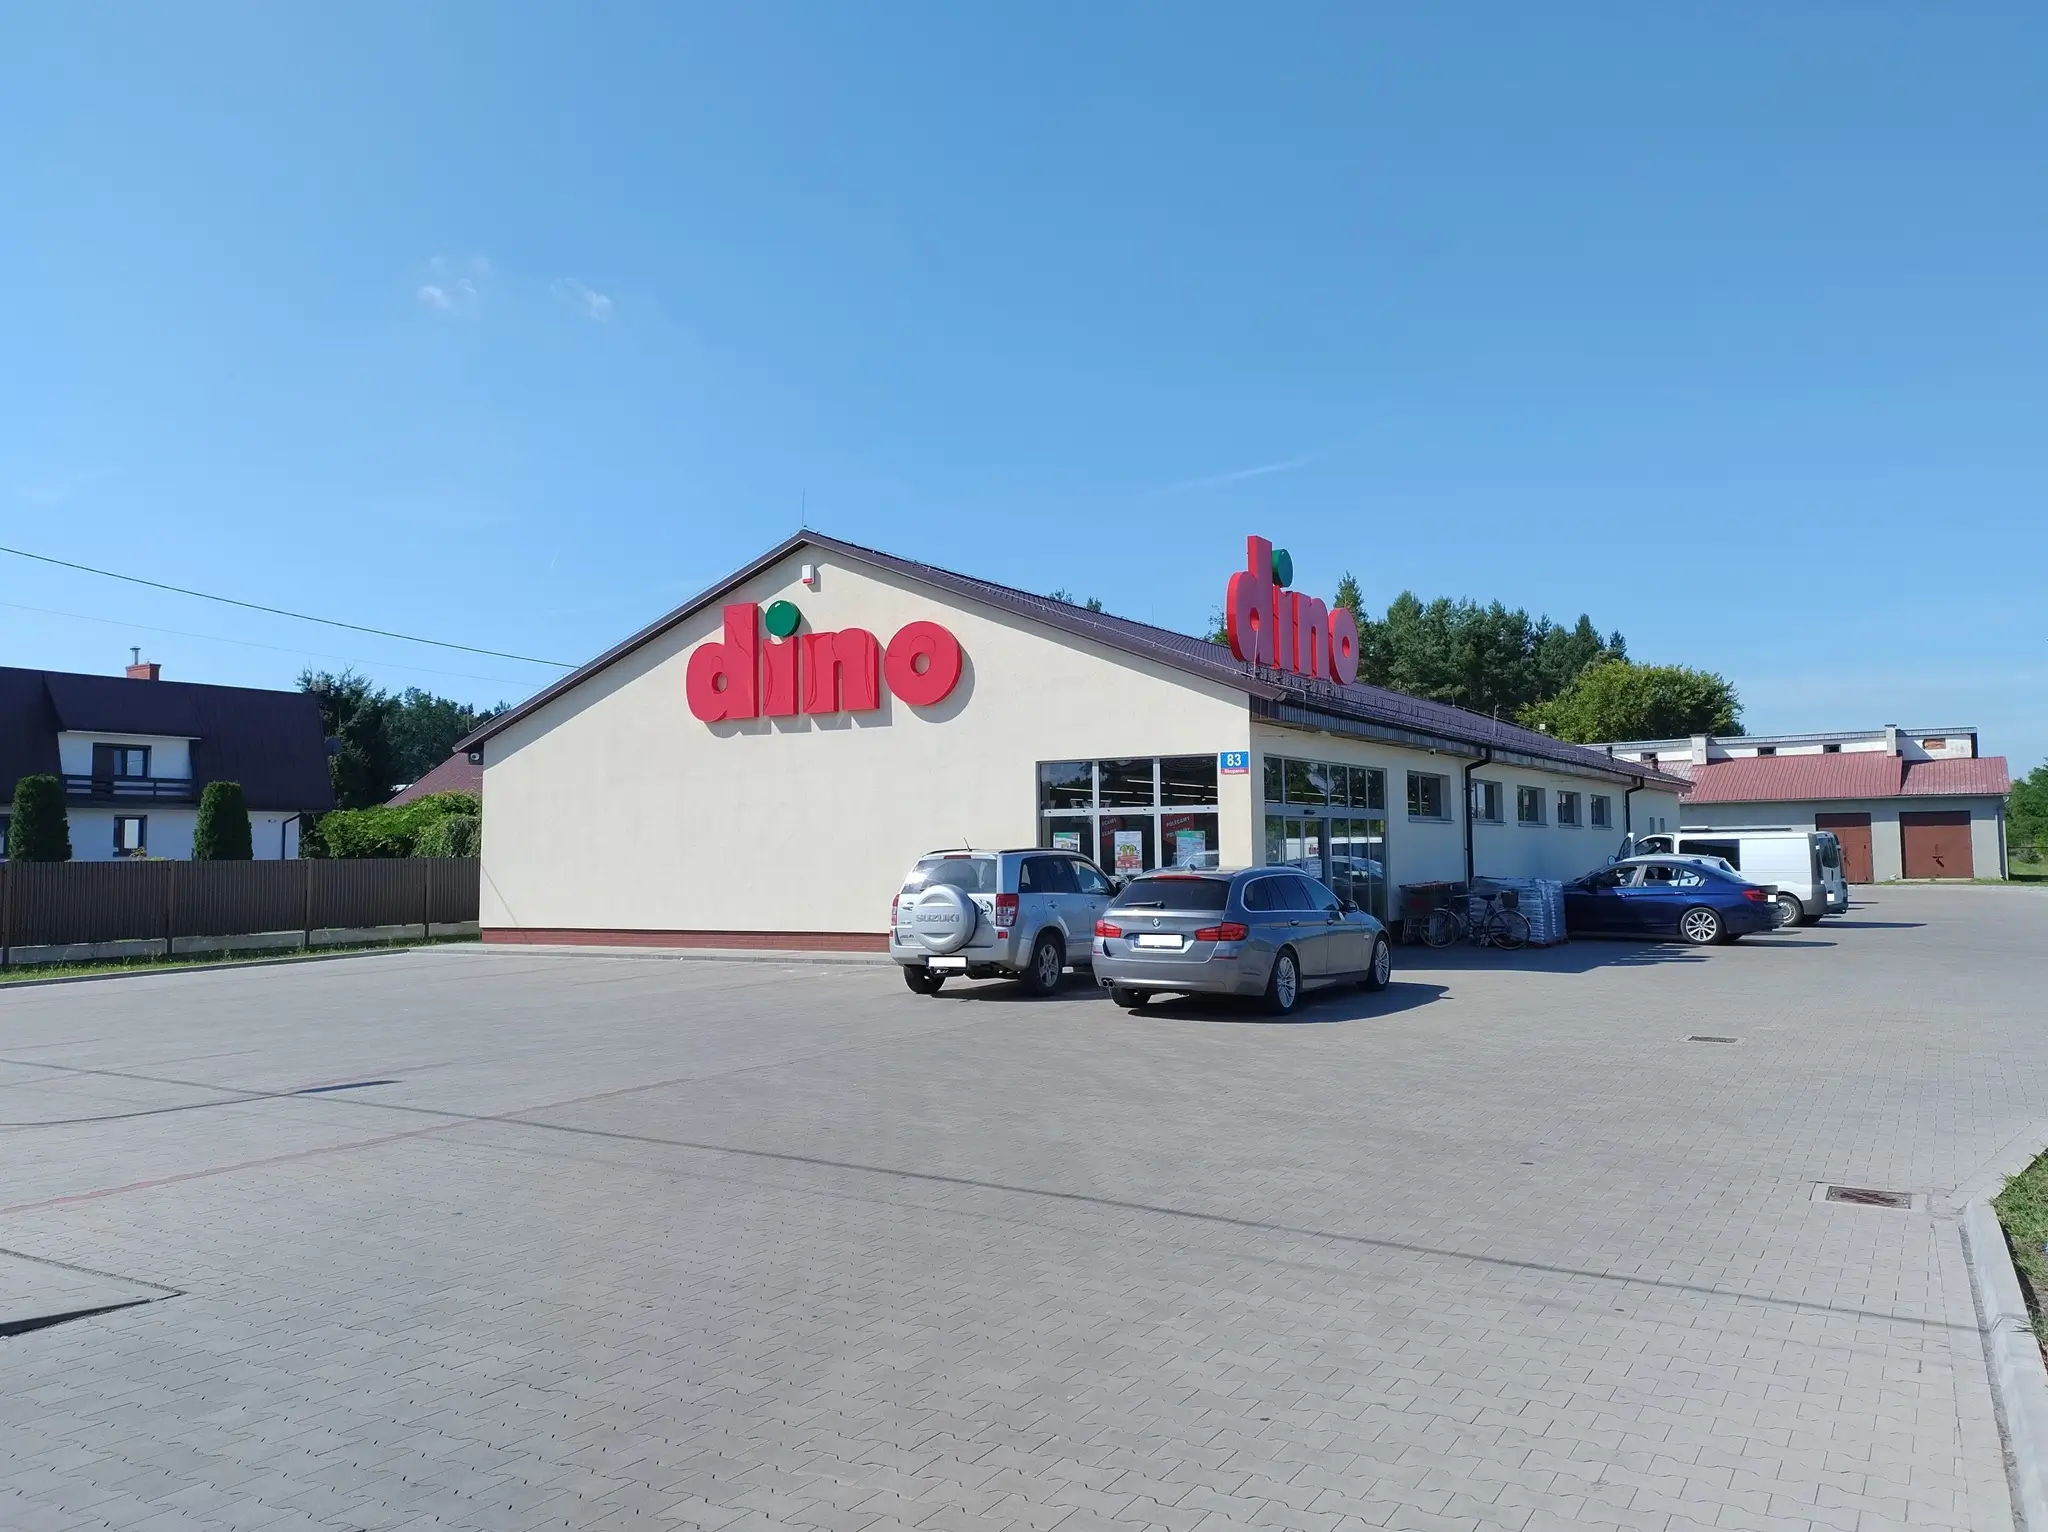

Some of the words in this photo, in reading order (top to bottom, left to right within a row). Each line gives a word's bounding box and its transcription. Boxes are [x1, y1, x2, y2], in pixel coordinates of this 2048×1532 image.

[1226, 535, 1360, 685] dino
[686, 600, 963, 722] dino
[1227, 754, 1241, 766] 83
[916, 913, 960, 922] SUZUKI
